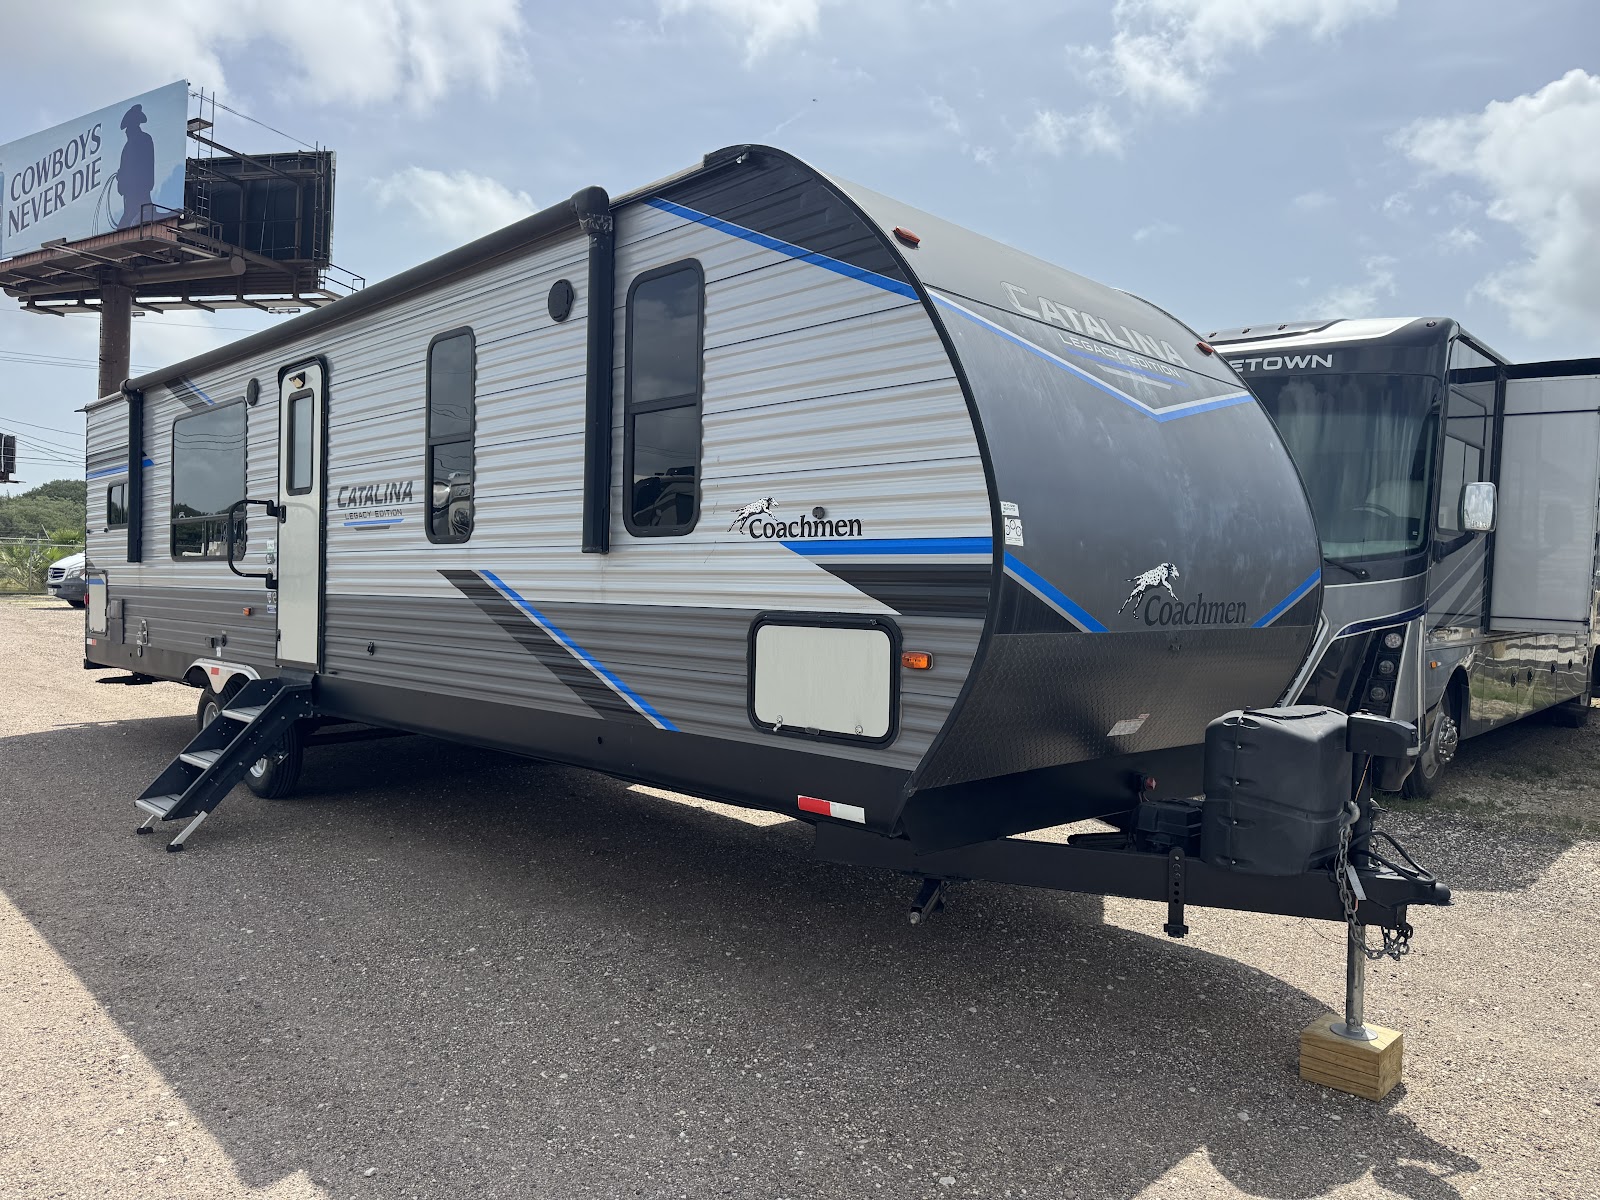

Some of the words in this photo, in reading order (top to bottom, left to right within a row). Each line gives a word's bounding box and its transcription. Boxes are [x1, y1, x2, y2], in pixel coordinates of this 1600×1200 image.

[10, 123, 102, 201] COWBOYS
[8, 180, 66, 237] NEVER
[71, 156, 102, 202] DIE
[1000, 280, 1189, 368] CATALINA
[1059, 333, 1121, 363] LEGACY
[1128, 355, 1180, 379] EDITION
[337, 480, 413, 508] CATALINA
[344, 511, 371, 520] LEGACY
[374, 509, 403, 518] EDITION
[749, 514, 862, 539] Coachmen
[1144, 593, 1247, 627] Coachmen
